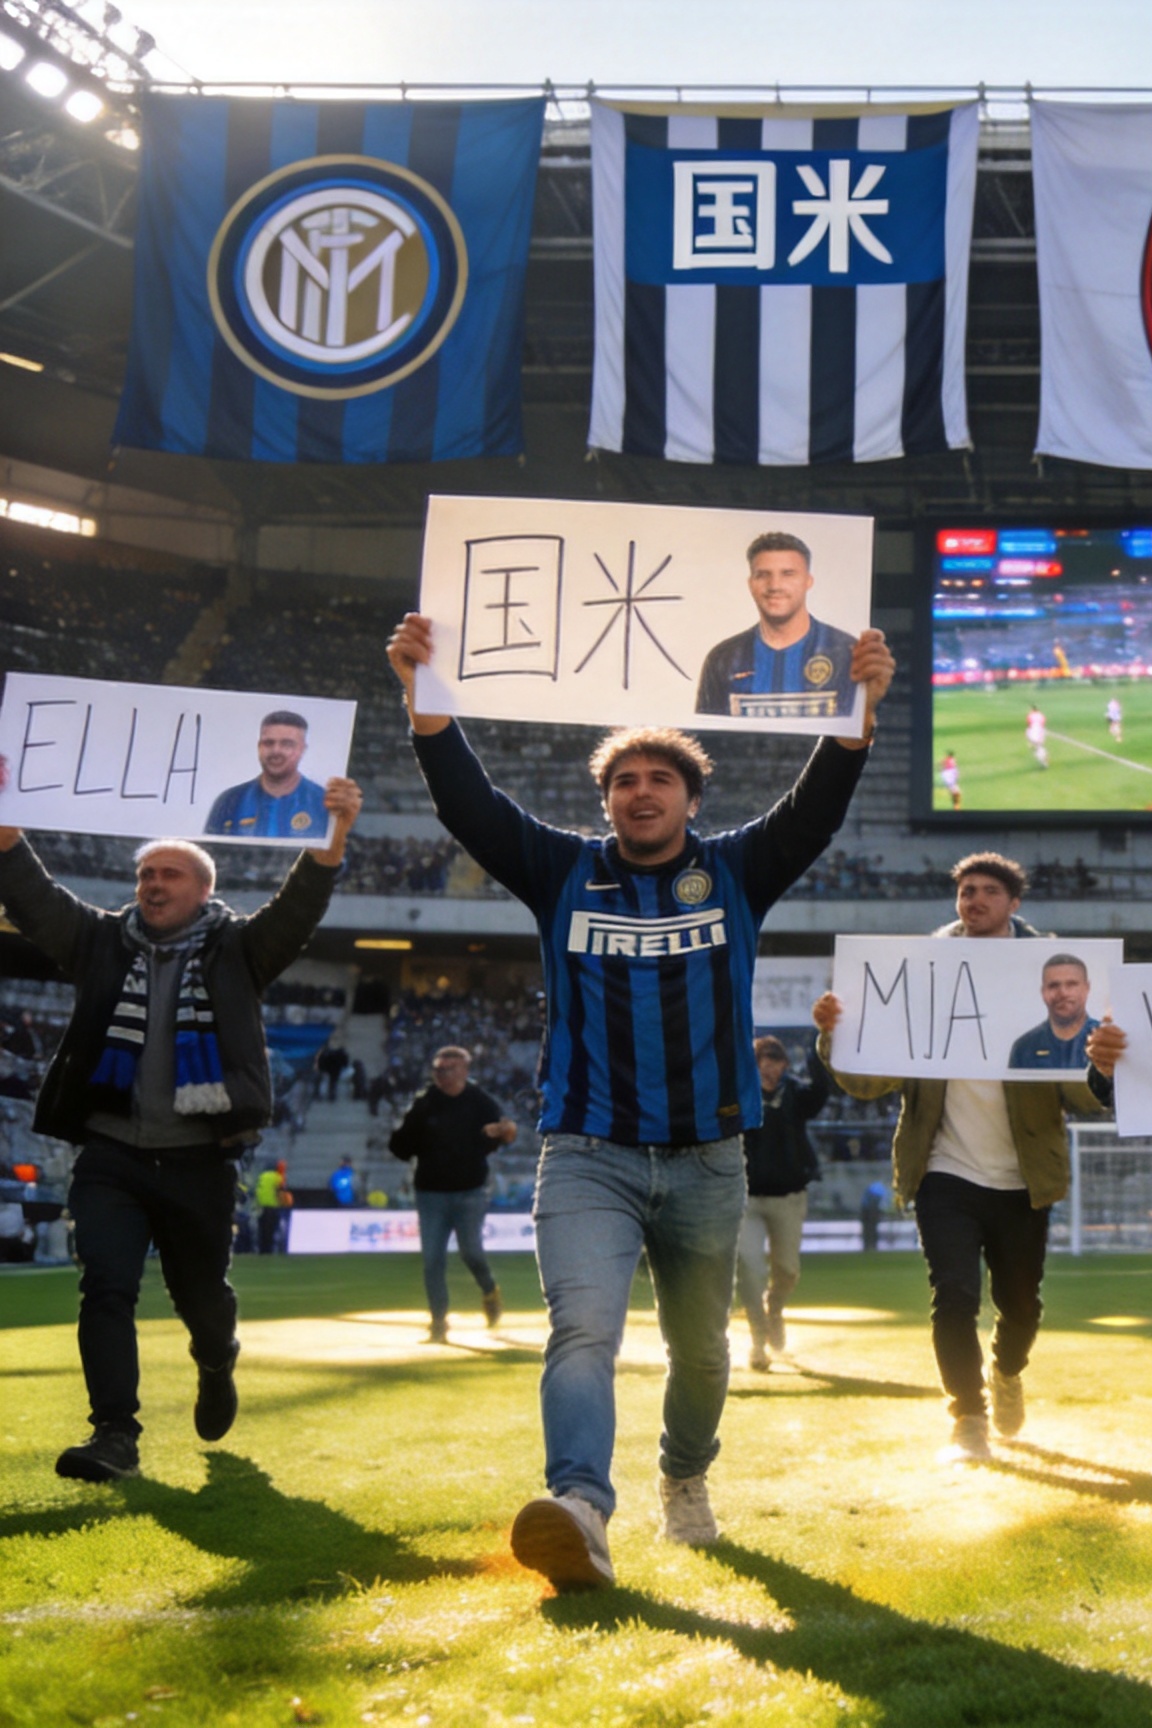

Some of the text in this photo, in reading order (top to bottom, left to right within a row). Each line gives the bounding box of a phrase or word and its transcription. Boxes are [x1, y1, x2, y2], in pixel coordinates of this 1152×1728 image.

[673, 159, 893, 273] 国米
[458, 535, 692, 690] 国米
[18, 701, 201, 804] ELLA
[567, 908, 727, 957] PIRELLI
